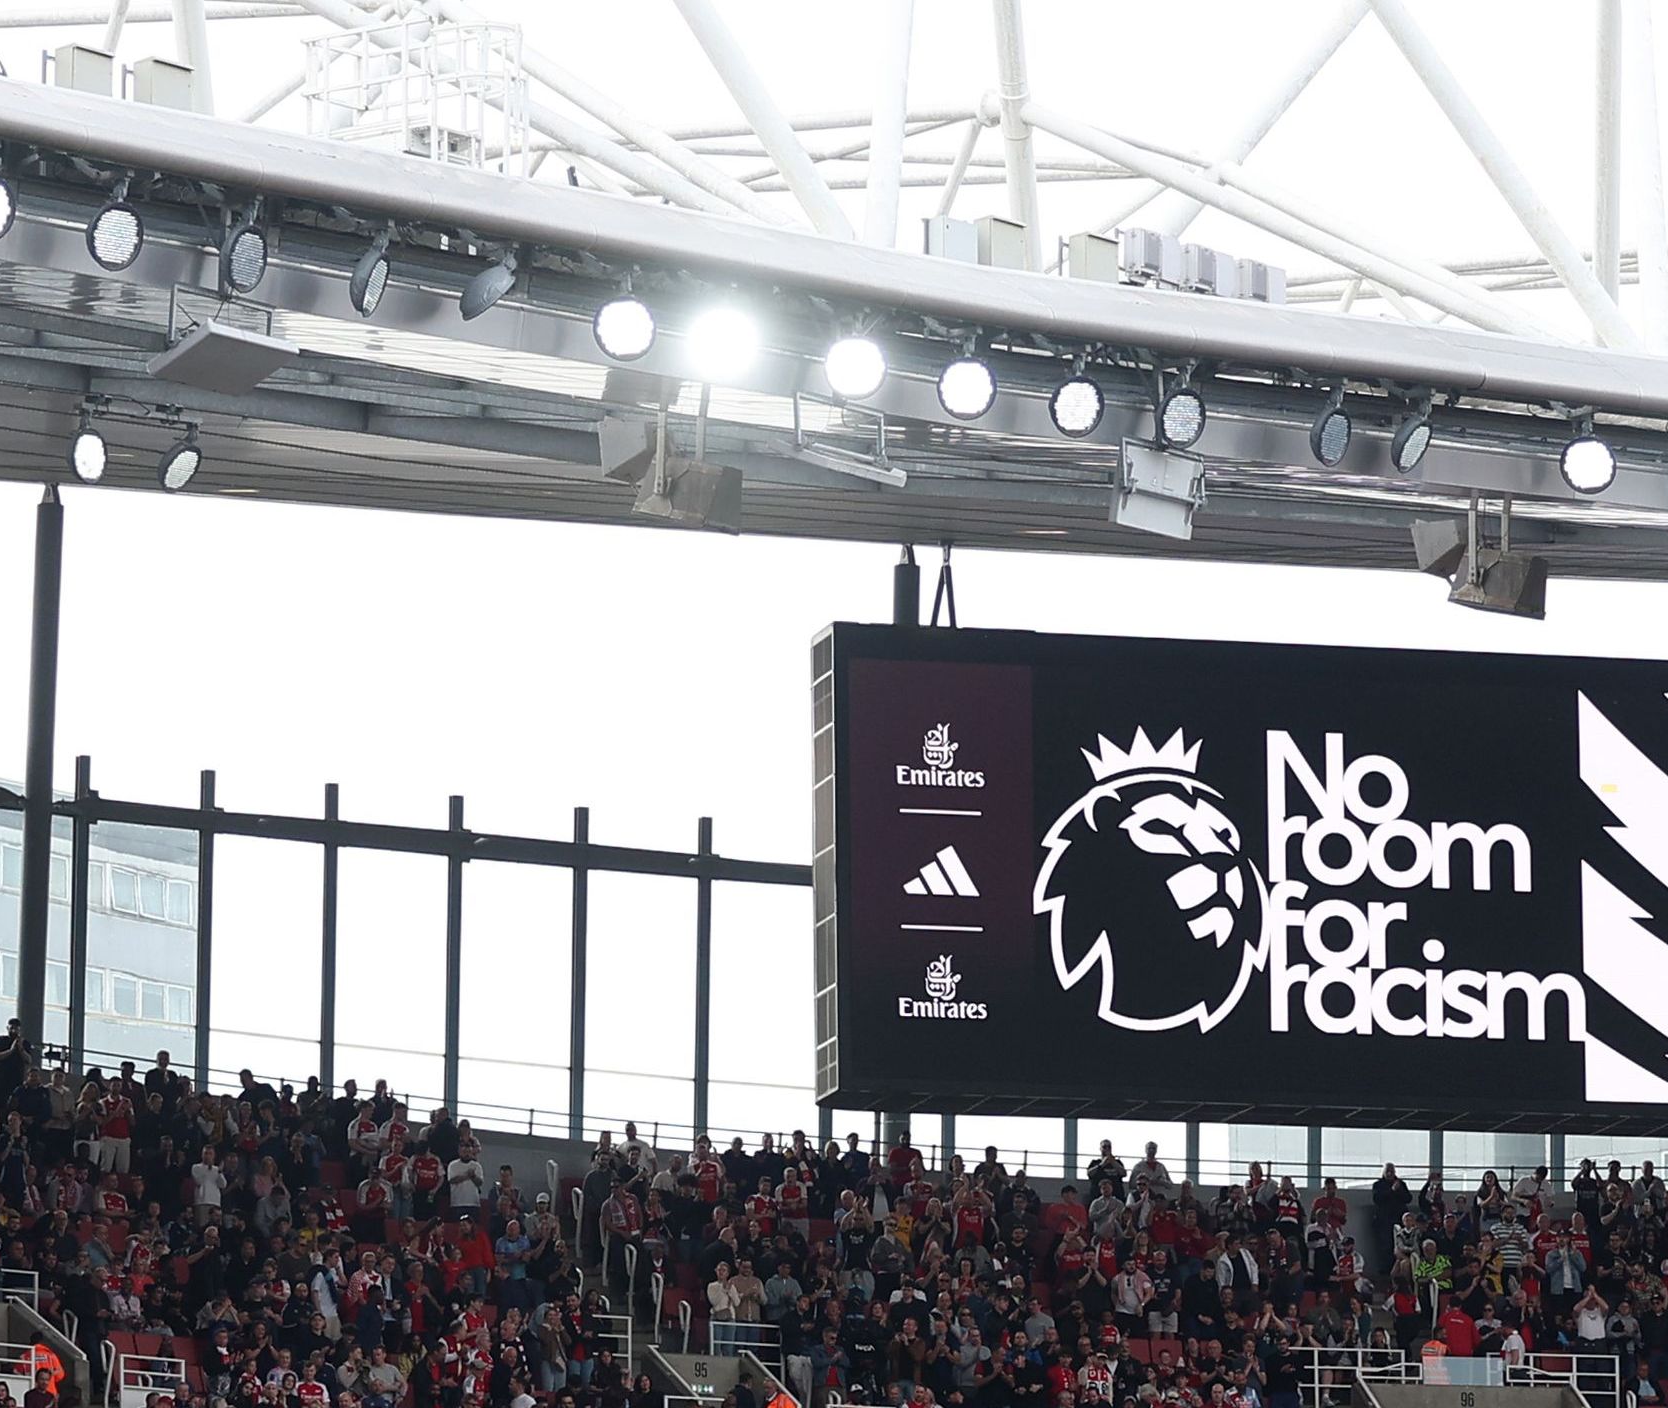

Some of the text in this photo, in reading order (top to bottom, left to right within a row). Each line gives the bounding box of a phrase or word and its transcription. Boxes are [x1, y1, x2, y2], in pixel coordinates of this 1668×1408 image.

[895, 764, 986, 788] Emirates
[1267, 730, 1409, 823] No
[1270, 817, 1531, 893] room
[1268, 881, 1408, 973] for
[897, 997, 988, 1020] Emirates
[1268, 939, 1587, 1042] racism
[693, 1362, 708, 1378] 95
[1459, 1391, 1474, 1407] 96
